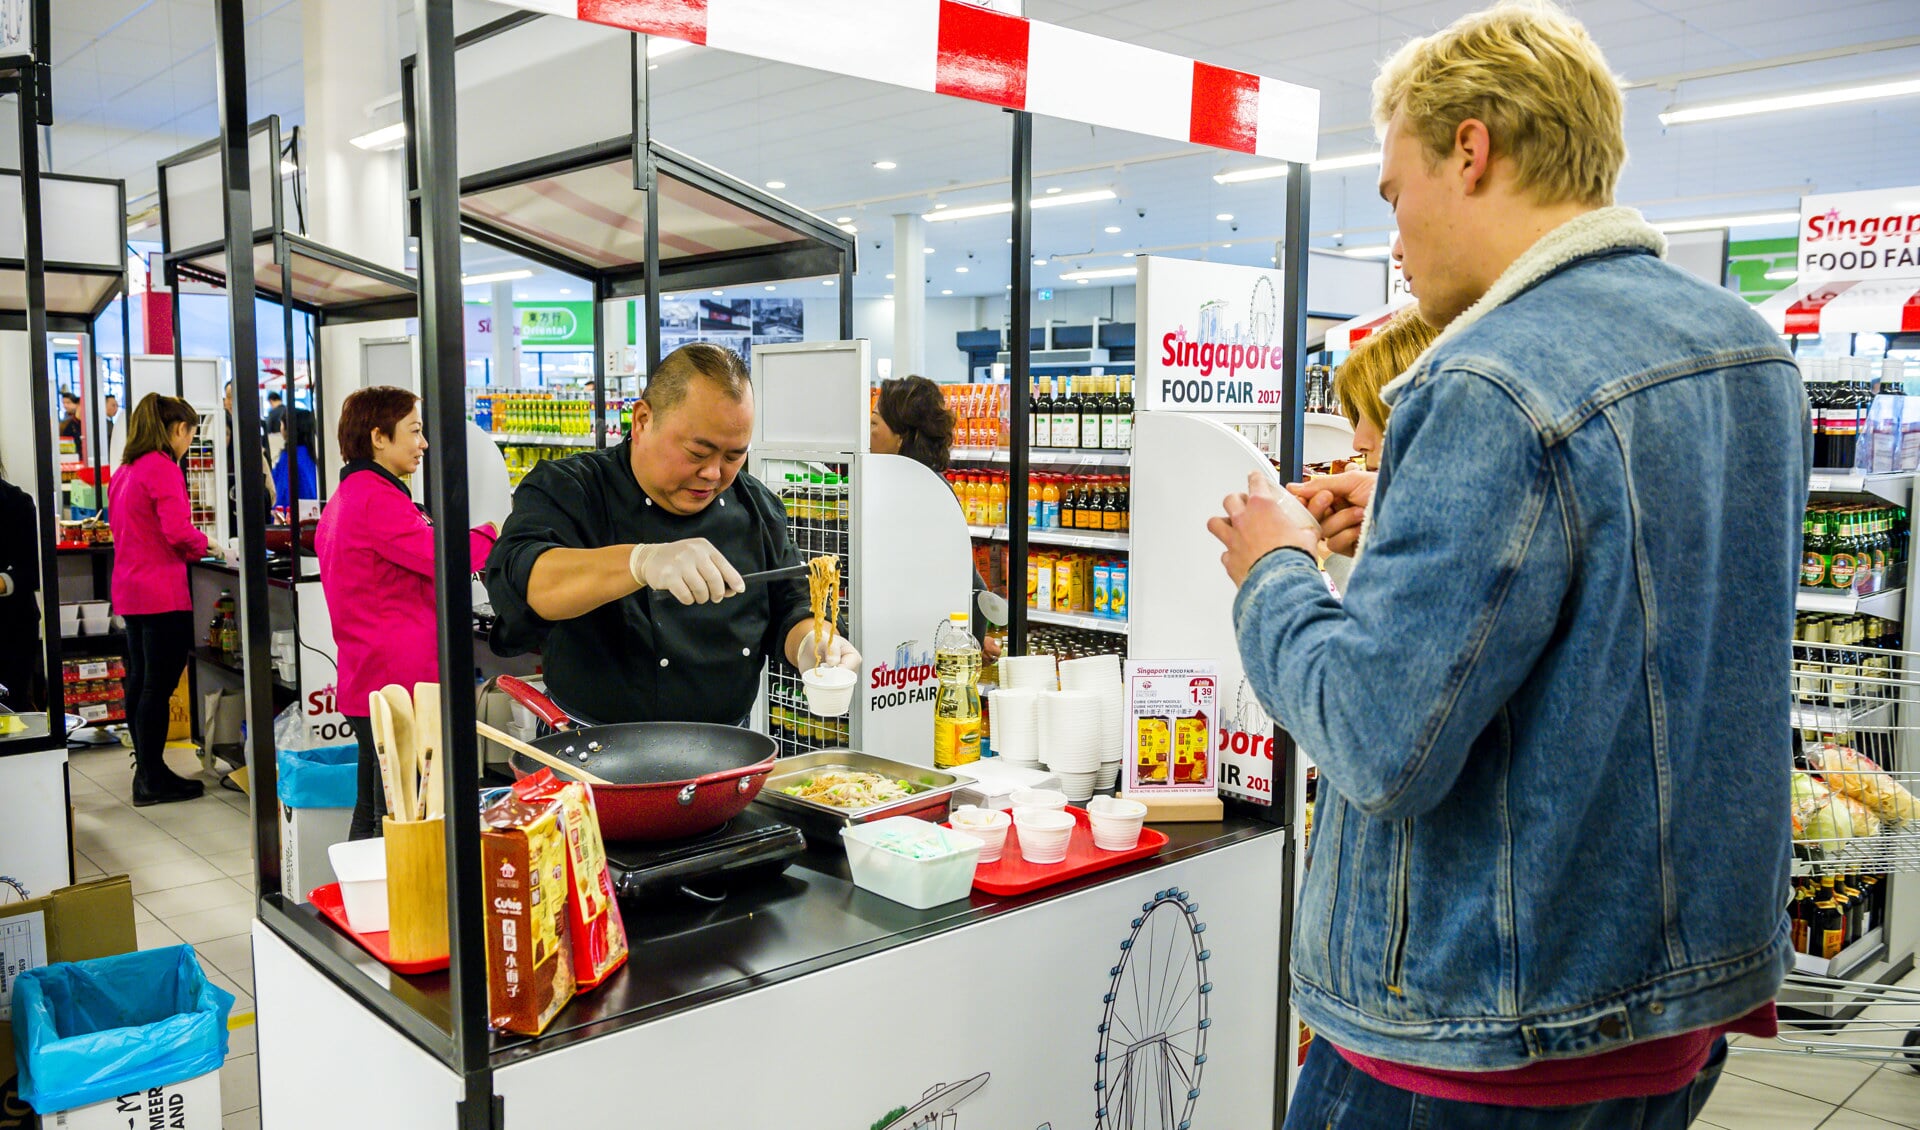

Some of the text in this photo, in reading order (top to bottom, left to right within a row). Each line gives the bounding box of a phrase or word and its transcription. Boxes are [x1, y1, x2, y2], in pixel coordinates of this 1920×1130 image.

[1806, 250, 1877, 272] FOOD
[1161, 330, 1282, 378] Singapore
[1162, 379, 1281, 404] FOOD FAIR 2017
[1137, 667, 1169, 675] Singapore
[871, 686, 937, 712] FOOD FAIR
[1218, 762, 1273, 793] IR 201
[494, 897, 523, 912] Cubie
[169, 1093, 185, 1129] AND
